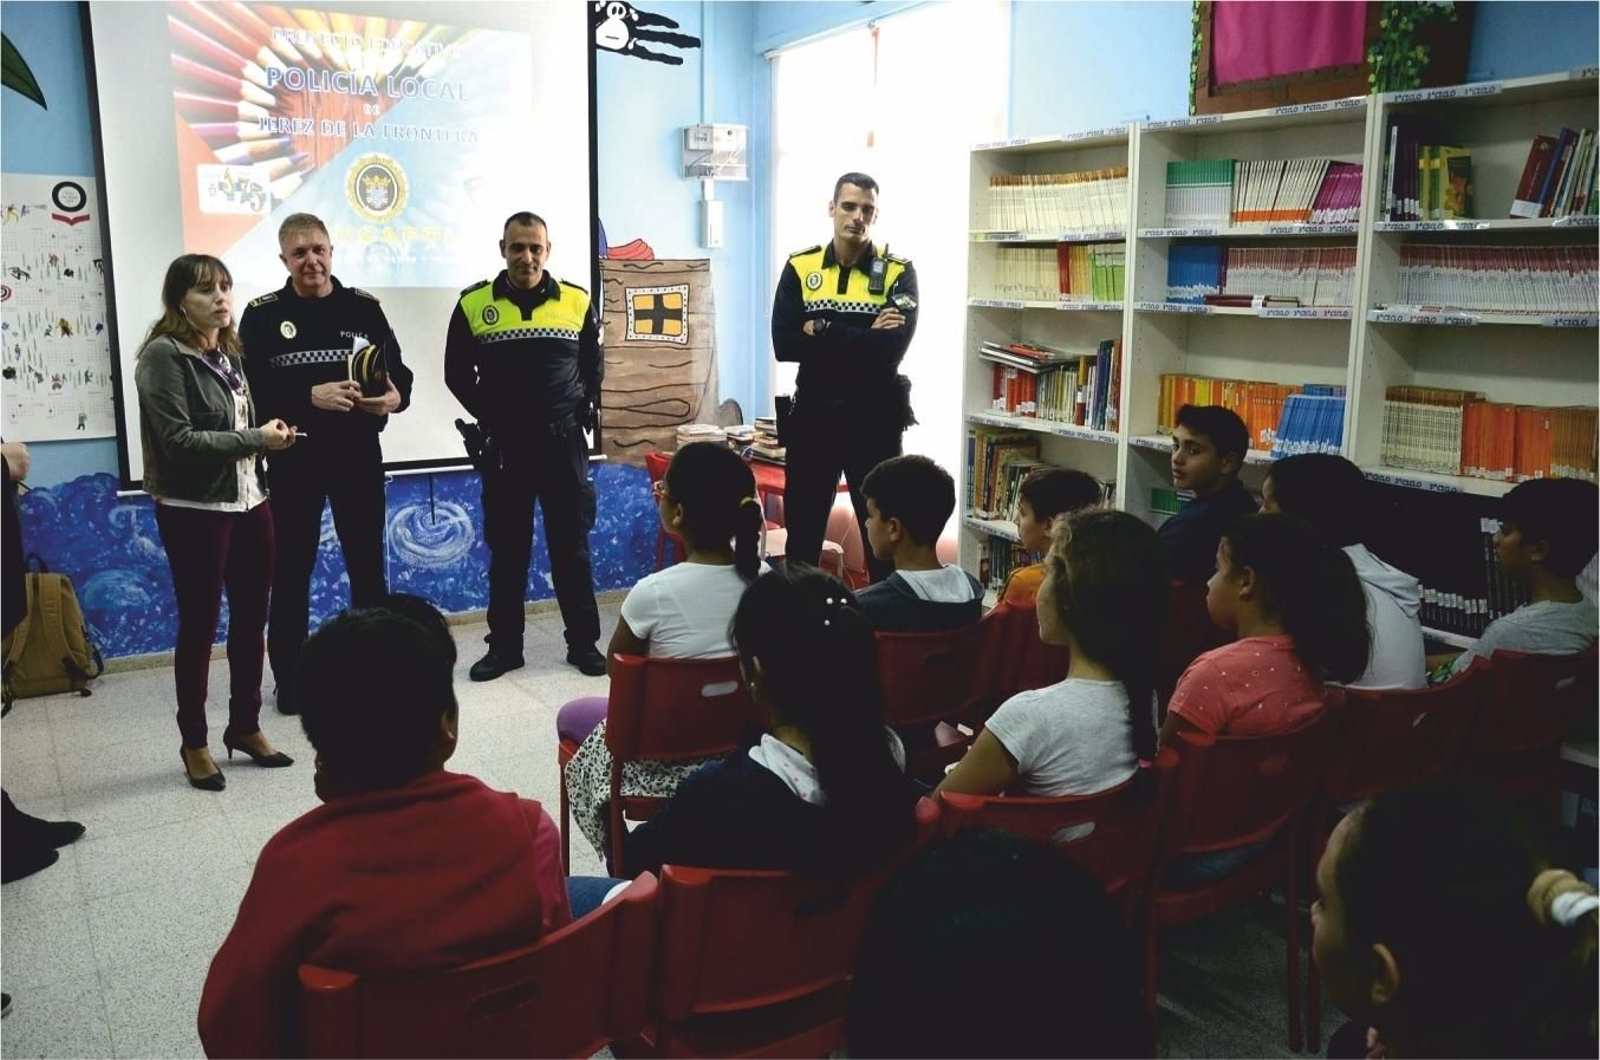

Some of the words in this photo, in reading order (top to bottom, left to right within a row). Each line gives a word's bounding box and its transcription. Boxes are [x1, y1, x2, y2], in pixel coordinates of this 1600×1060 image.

[265, 66, 379, 97] POLICÍA
[386, 76, 472, 102] LOCAL
[257, 116, 314, 135] JEREZ
[321, 120, 346, 136] DE
